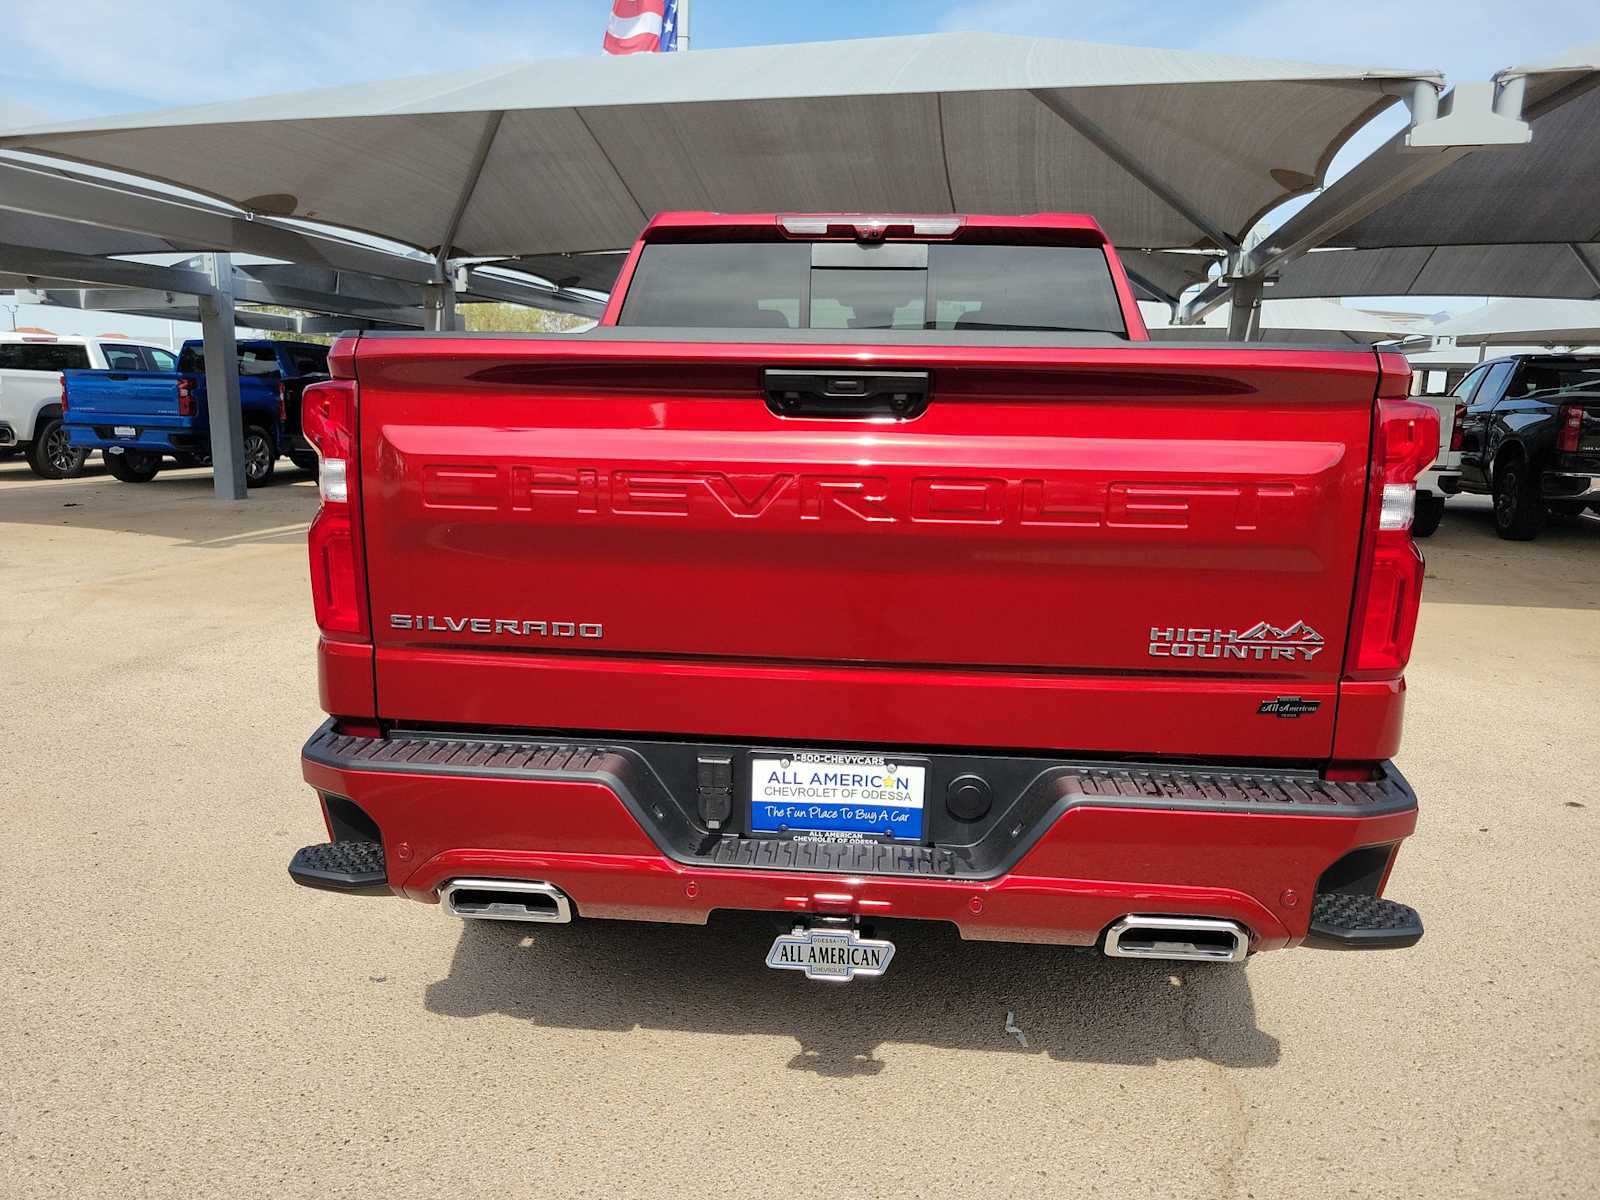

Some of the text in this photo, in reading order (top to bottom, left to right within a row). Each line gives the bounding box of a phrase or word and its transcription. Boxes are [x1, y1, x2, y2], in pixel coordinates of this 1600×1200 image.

[422, 464, 1298, 530] CHEVROLET
[390, 613, 603, 638] SILVERADO
[1150, 627, 1238, 643] HIGH
[1149, 642, 1323, 661] COUNTRY
[792, 754, 885, 766] 1-800-CHEVYCARS
[767, 771, 803, 785] ALL
[764, 786, 912, 802] CHEVROLET OF ODESSA
[765, 805, 910, 823] The Fun Place To Buy A Car
[793, 835, 836, 844] CHEVROLET
[780, 945, 880, 967] ALL AMERICAN
